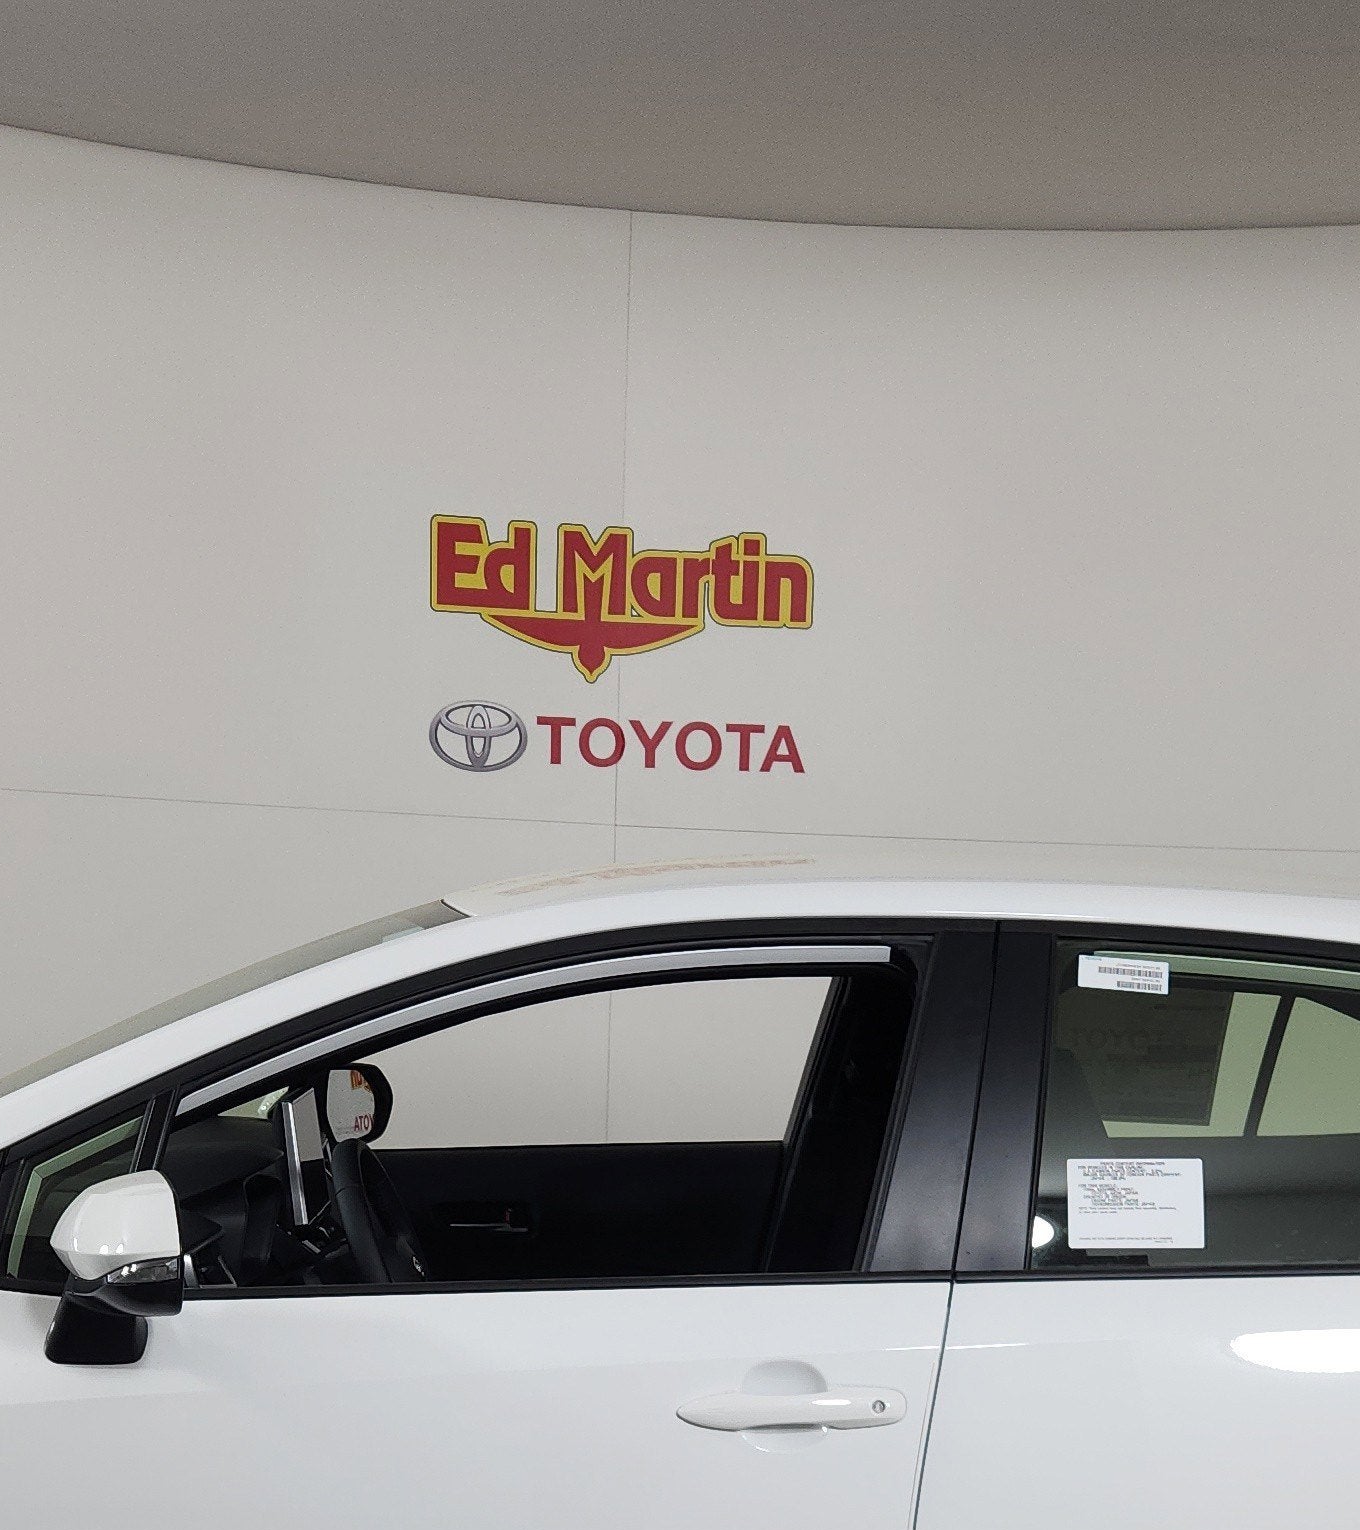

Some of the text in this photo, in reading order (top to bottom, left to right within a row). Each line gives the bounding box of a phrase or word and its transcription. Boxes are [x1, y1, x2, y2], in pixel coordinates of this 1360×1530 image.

[432, 516, 813, 628] Ed Martin
[536, 715, 805, 773] TOYOTA
